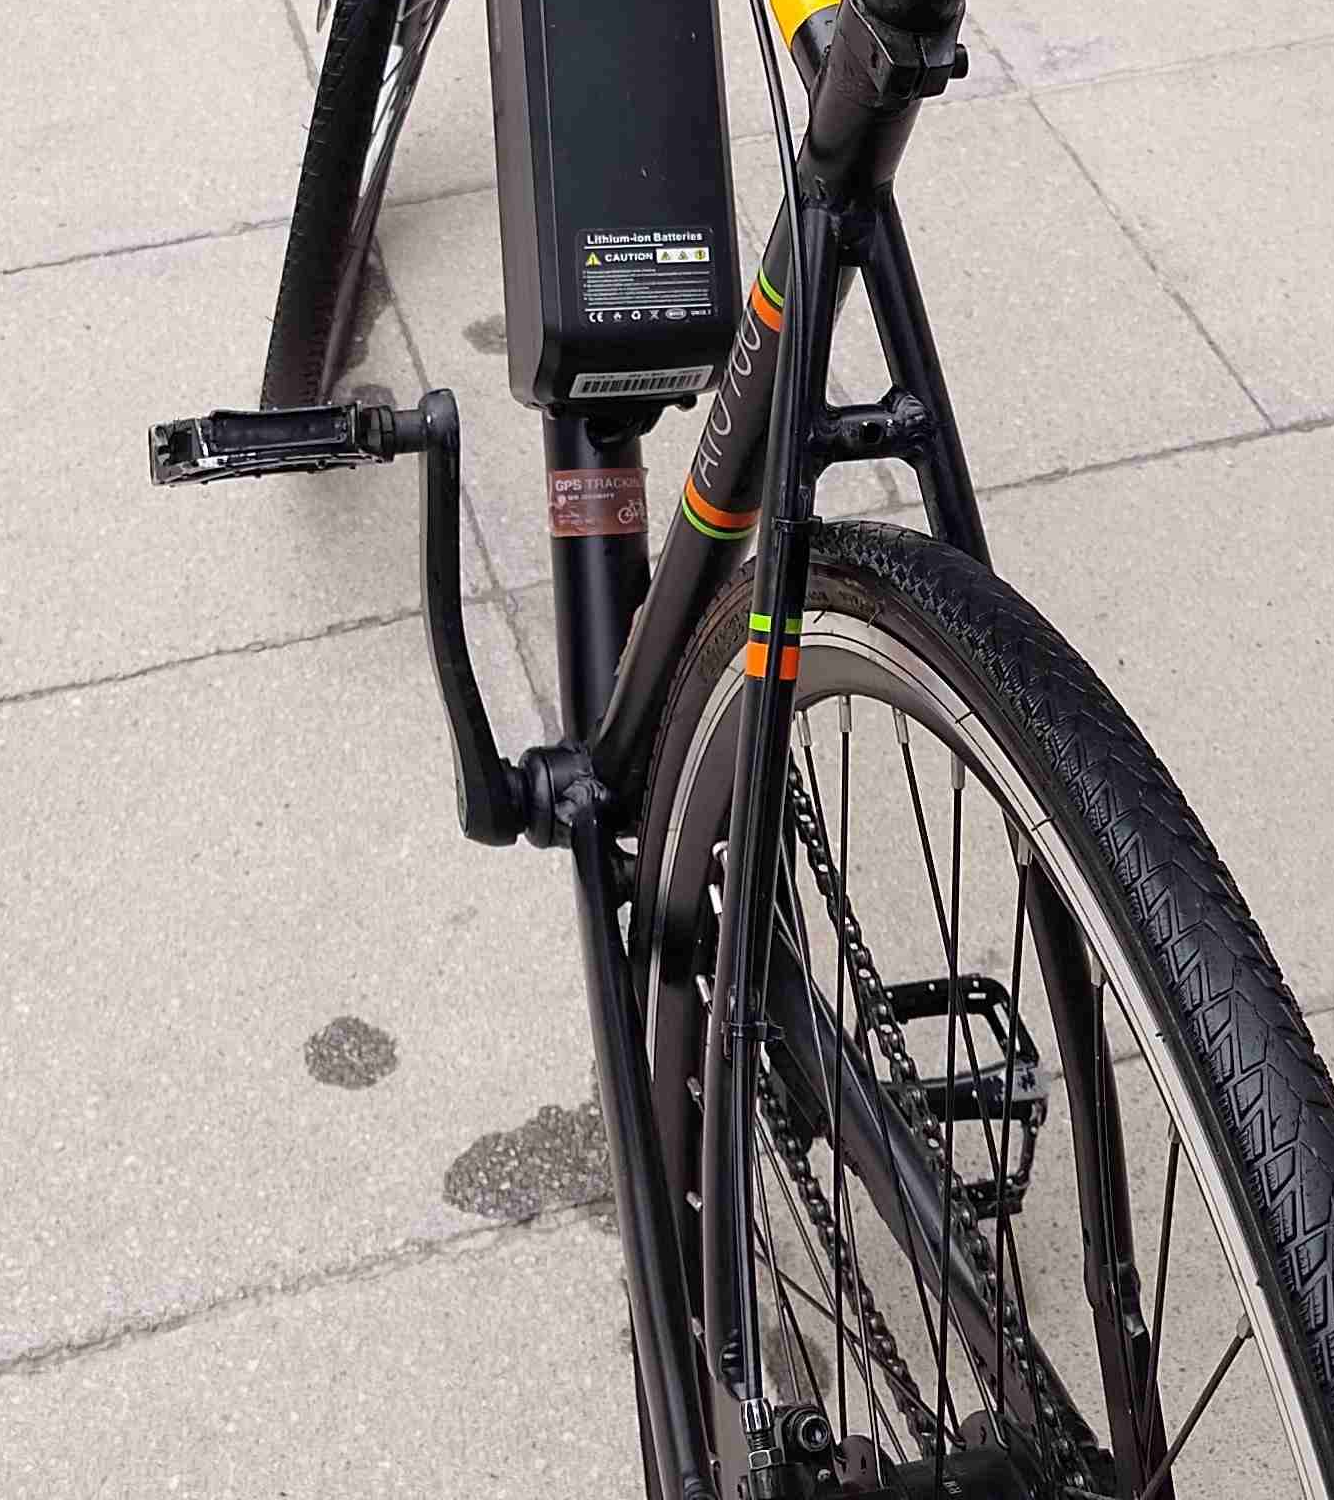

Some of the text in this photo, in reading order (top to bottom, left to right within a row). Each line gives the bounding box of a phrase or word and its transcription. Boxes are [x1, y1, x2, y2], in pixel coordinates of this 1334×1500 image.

[586, 231, 703, 245] Lithium-ion Batteries
[604, 251, 654, 263] CAUTION
[554, 478, 583, 492] GPS
